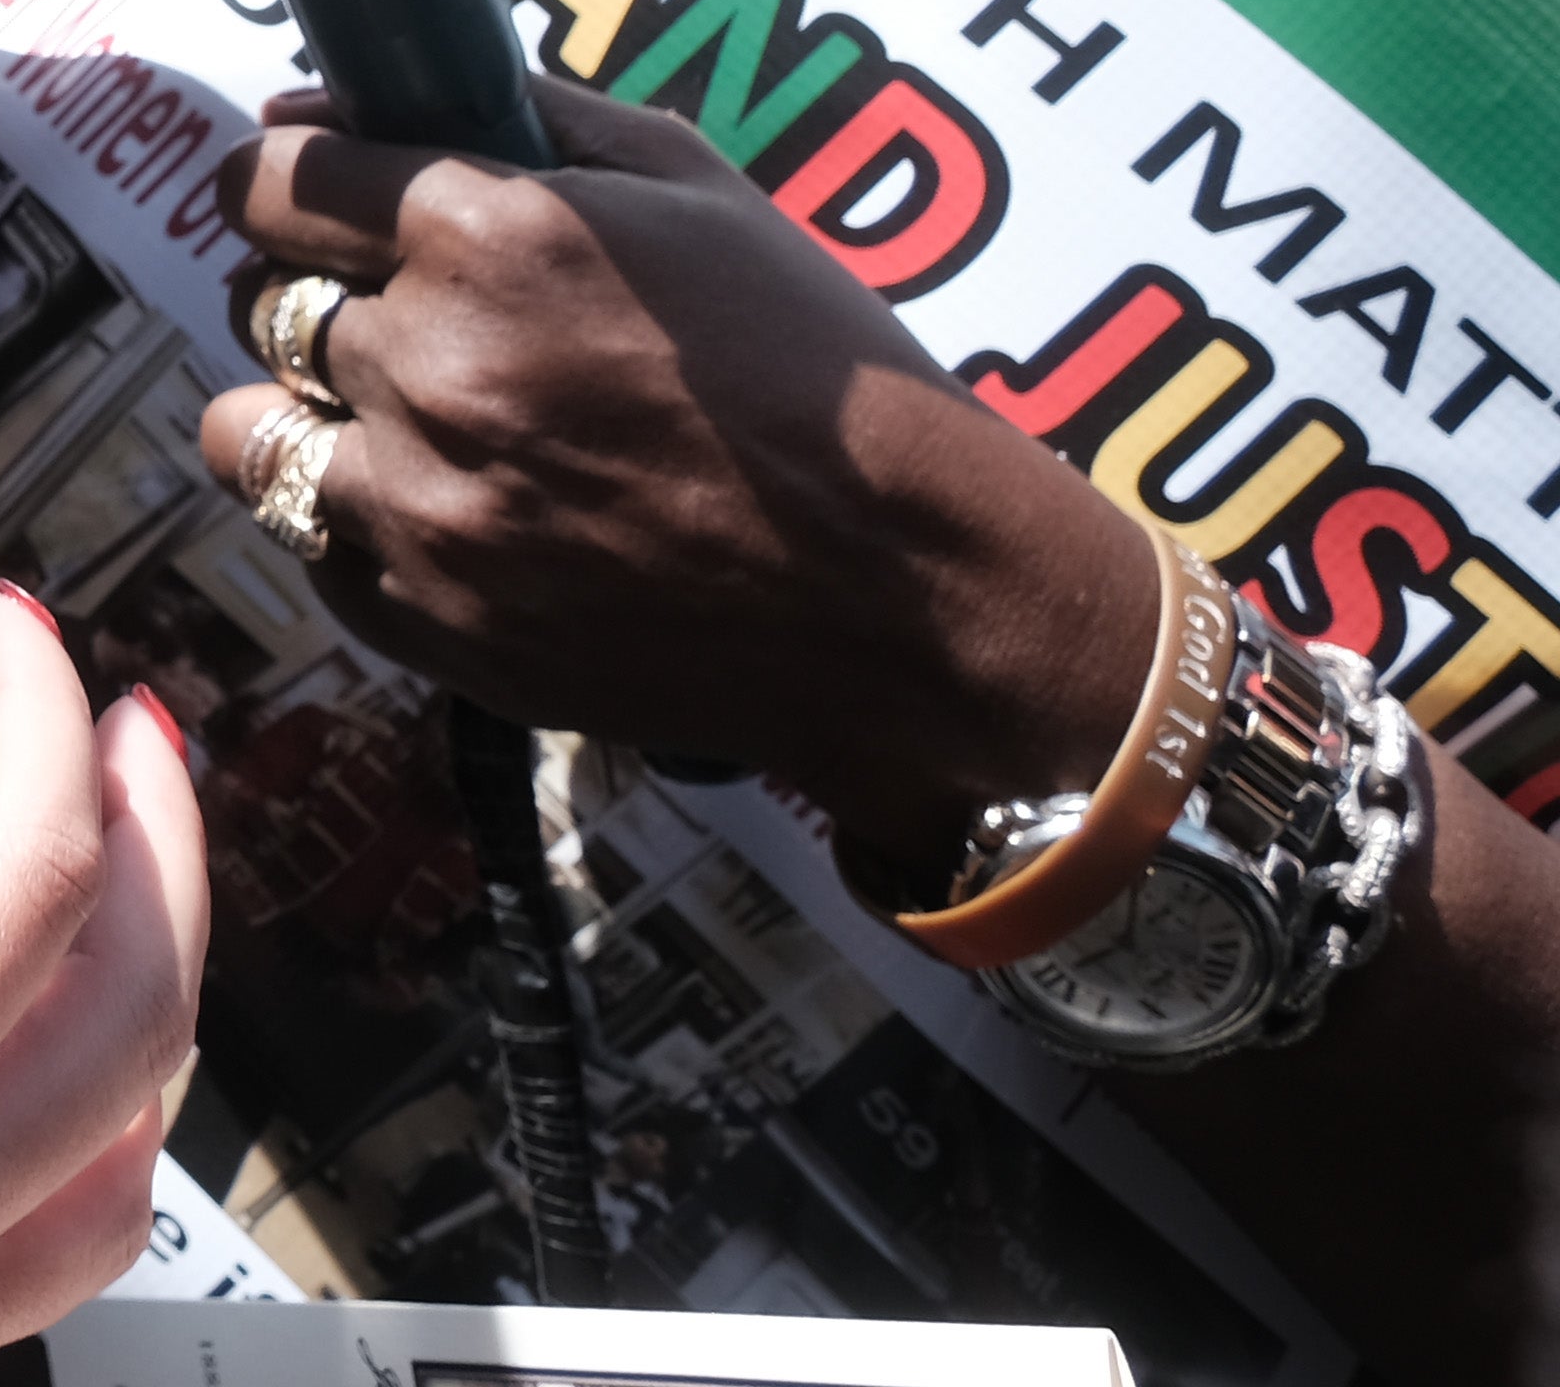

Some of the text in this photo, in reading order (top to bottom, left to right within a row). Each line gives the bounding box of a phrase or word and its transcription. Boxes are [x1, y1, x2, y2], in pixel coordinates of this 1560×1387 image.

[1183, 593, 1229, 704] God
[1144, 706, 1209, 782] 1st
[857, 1085, 944, 1172] 59
